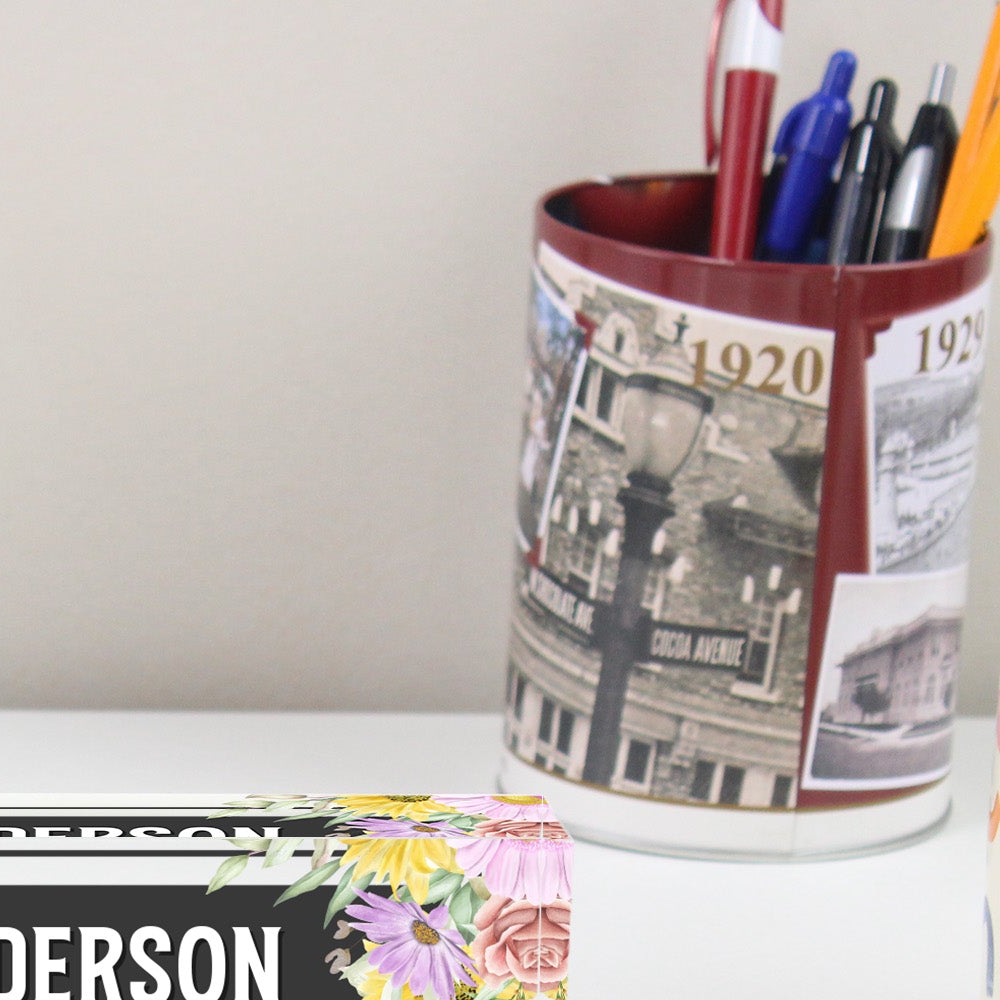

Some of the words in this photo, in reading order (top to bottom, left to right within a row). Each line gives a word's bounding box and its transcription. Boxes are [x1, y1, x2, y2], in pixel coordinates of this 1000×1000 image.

[690, 339, 824, 396] 1920
[915, 309, 984, 374] 1929
[650, 628, 692, 662] COCOA
[693, 634, 745, 667] AVENUE
